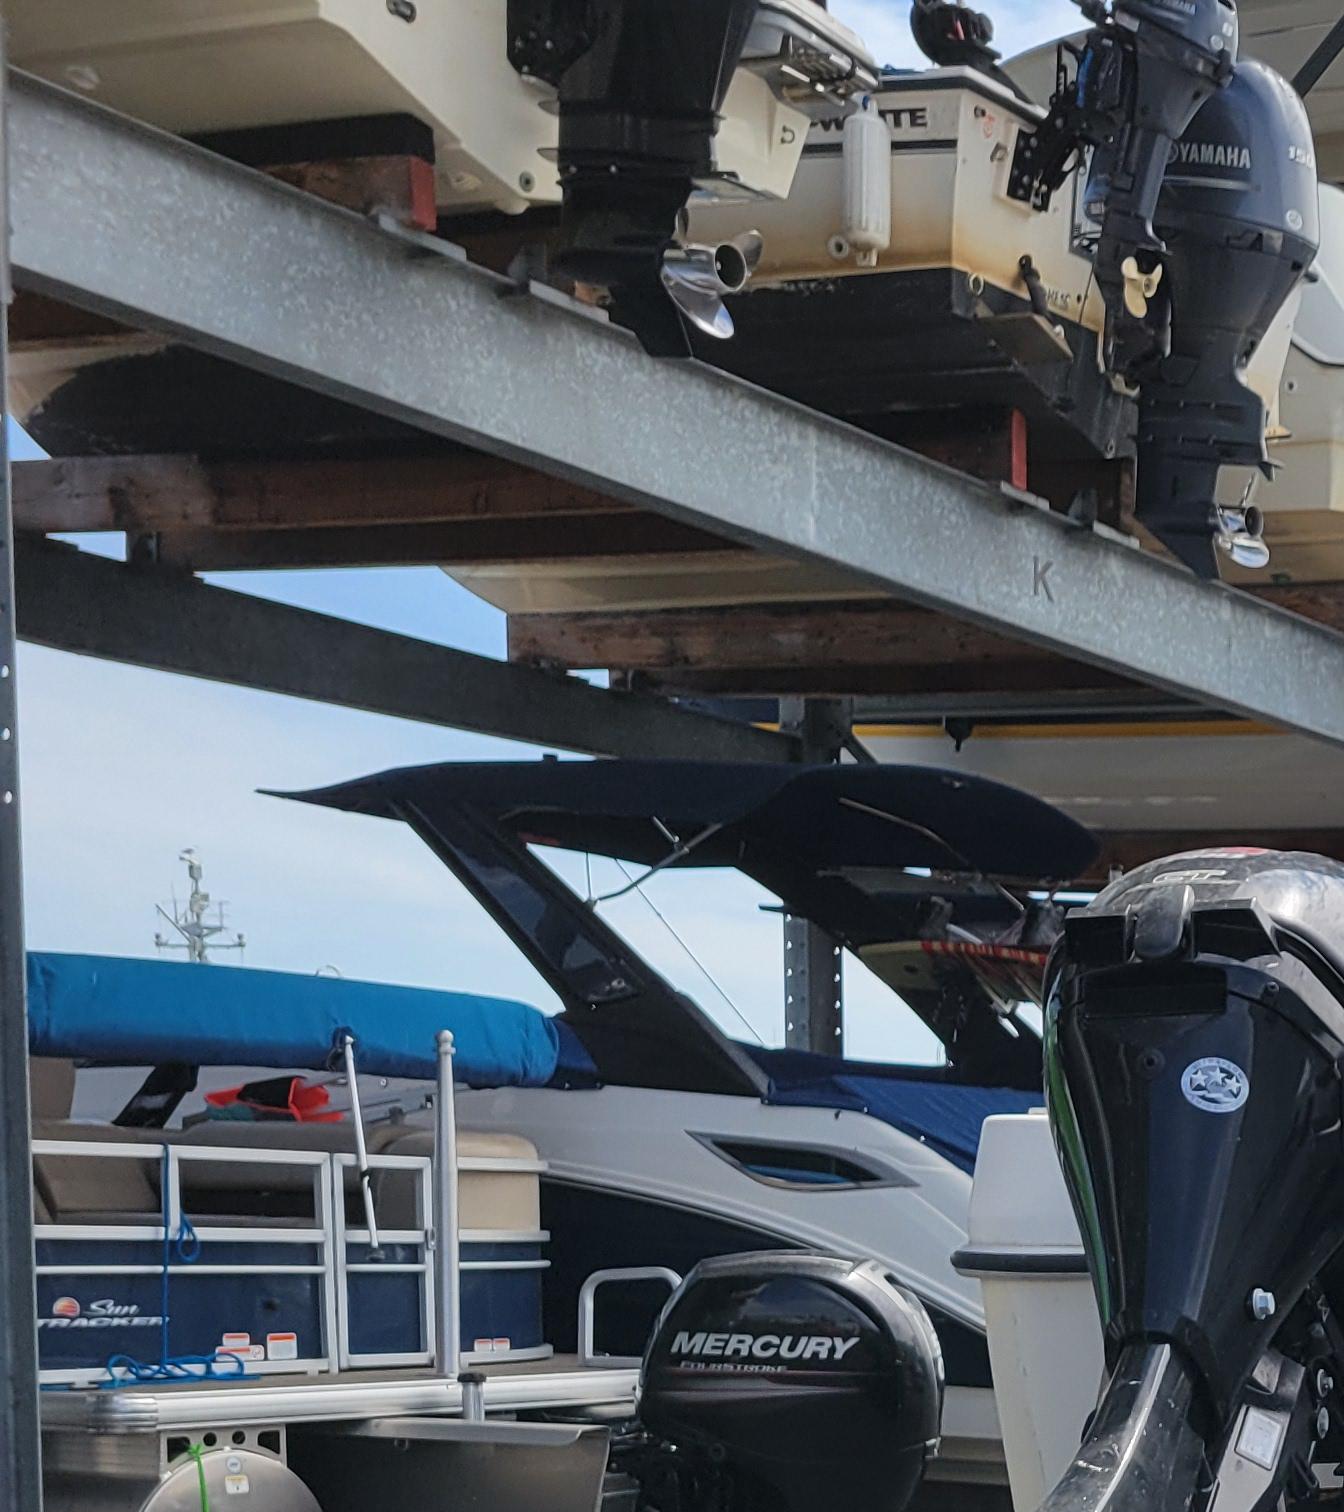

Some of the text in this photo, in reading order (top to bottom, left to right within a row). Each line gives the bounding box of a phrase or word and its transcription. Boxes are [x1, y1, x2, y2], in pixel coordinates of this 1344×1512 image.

[1179, 143, 1251, 169] YAMAHA
[1033, 555, 1055, 603] K
[83, 1299, 141, 1317] Sun
[37, 1316, 169, 1329] TRACKER
[670, 1331, 861, 1360] MERCURY
